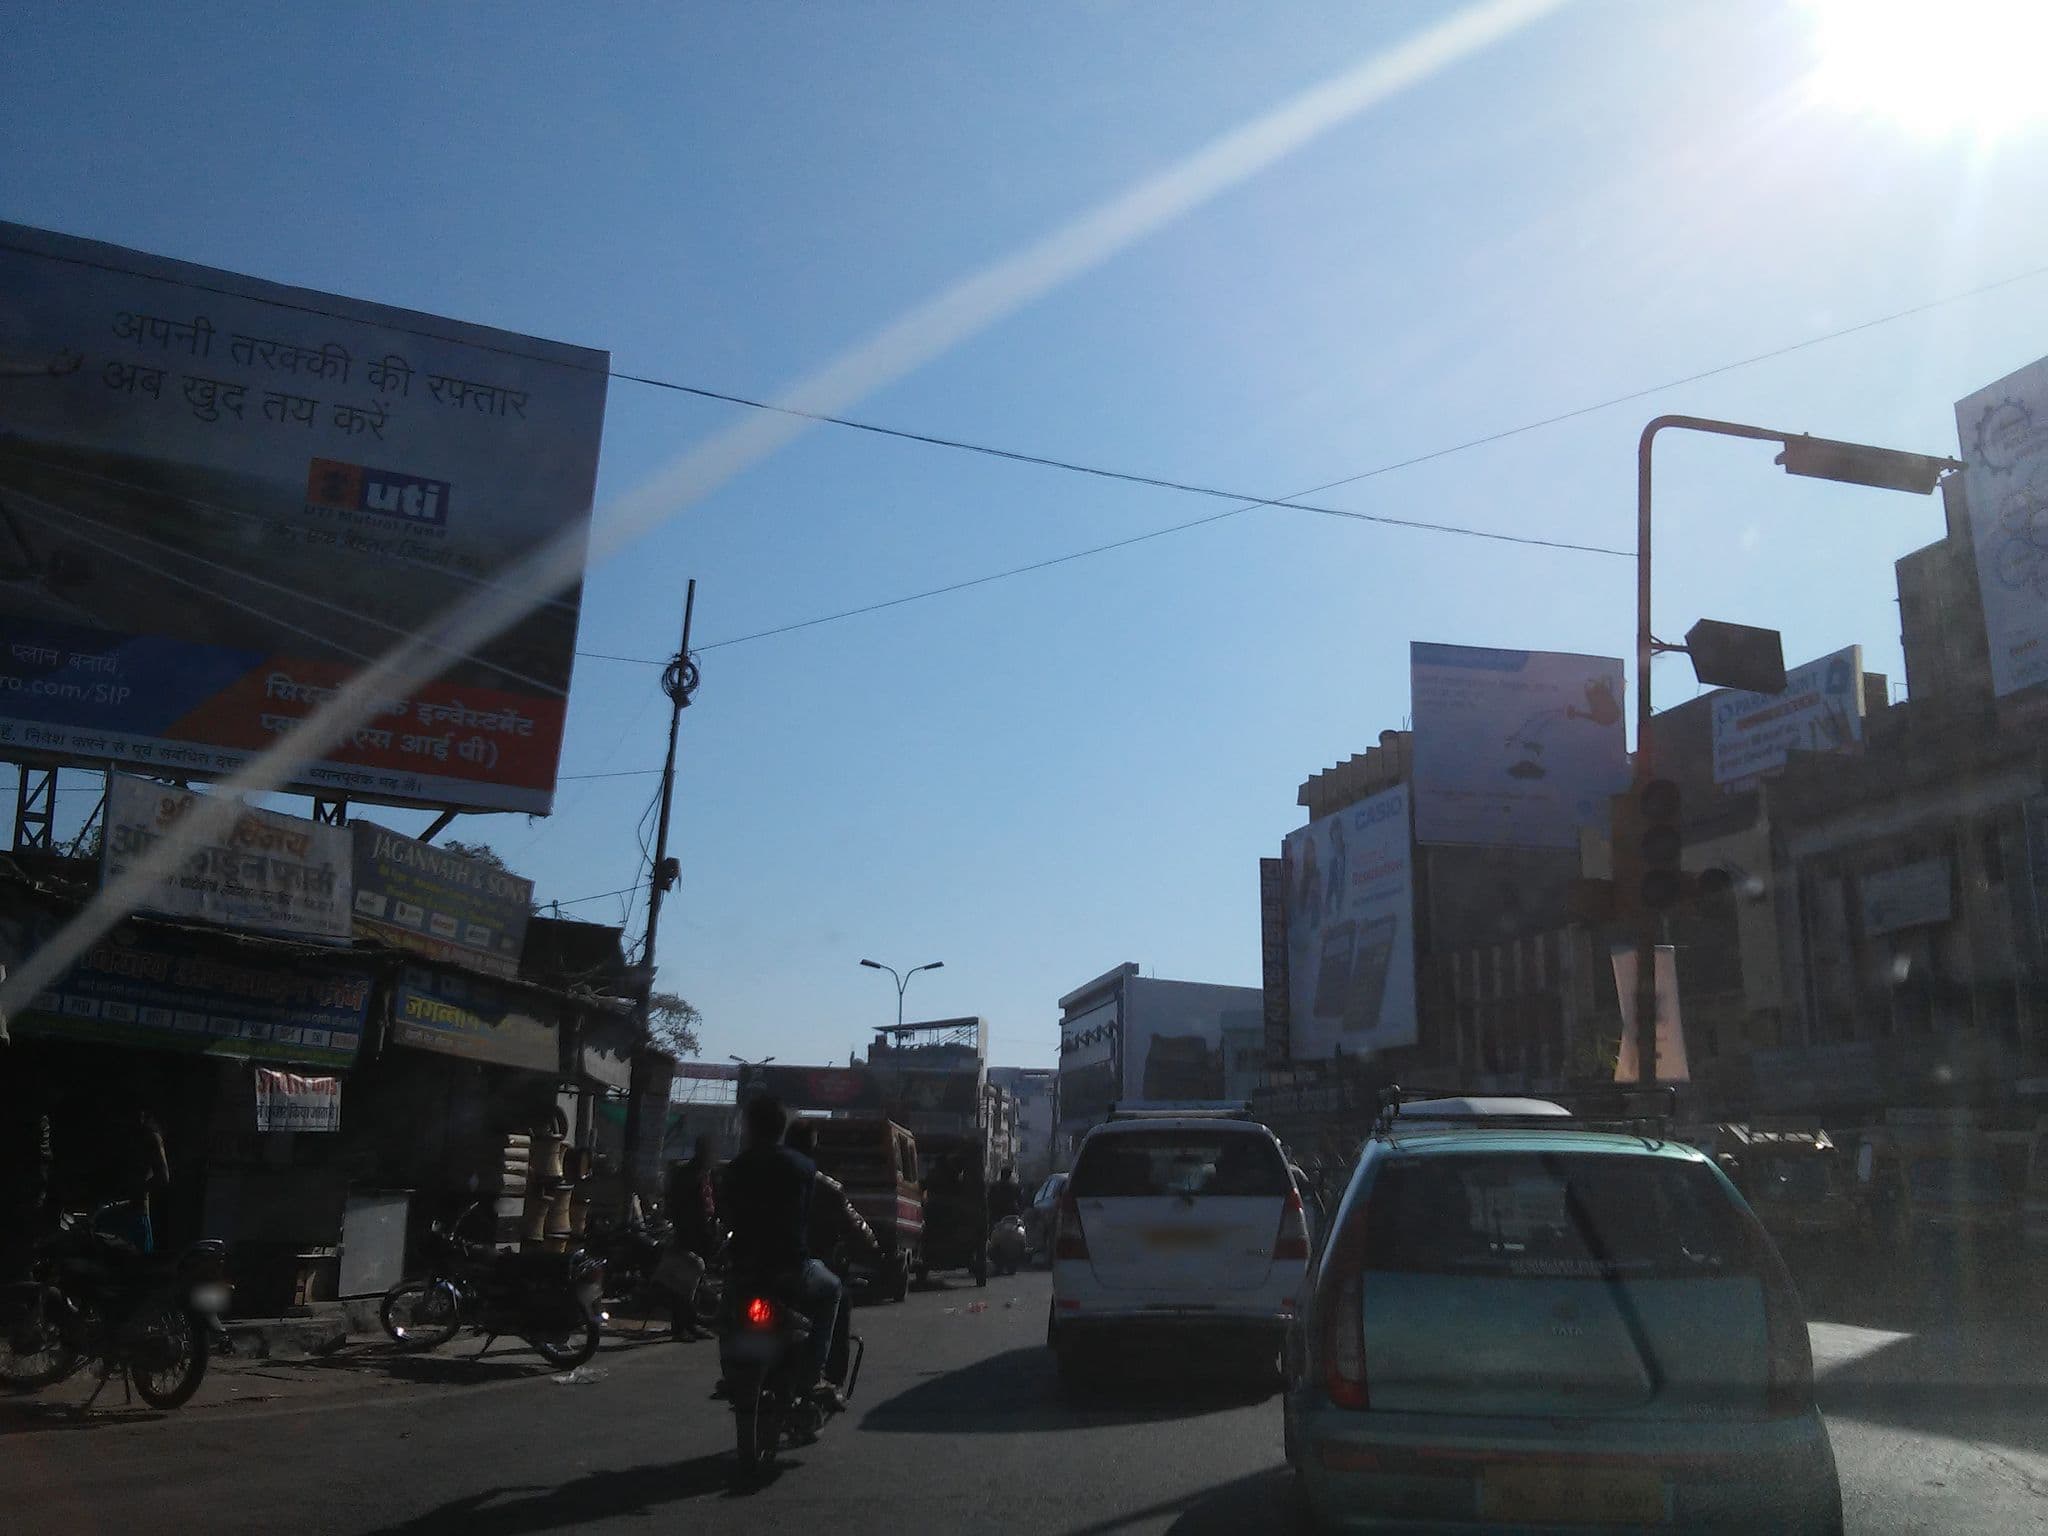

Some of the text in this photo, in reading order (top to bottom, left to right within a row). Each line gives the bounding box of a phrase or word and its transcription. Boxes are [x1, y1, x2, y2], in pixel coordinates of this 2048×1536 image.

[111, 310, 216, 358] अपनी
[231, 334, 351, 384] तरक्की
[368, 354, 415, 397] की
[102, 361, 390, 441] अब खुद तय करें
[366, 481, 441, 519] uti
[1354, 795, 1402, 831] CASIO
[371, 831, 470, 884] JAGANNATH
